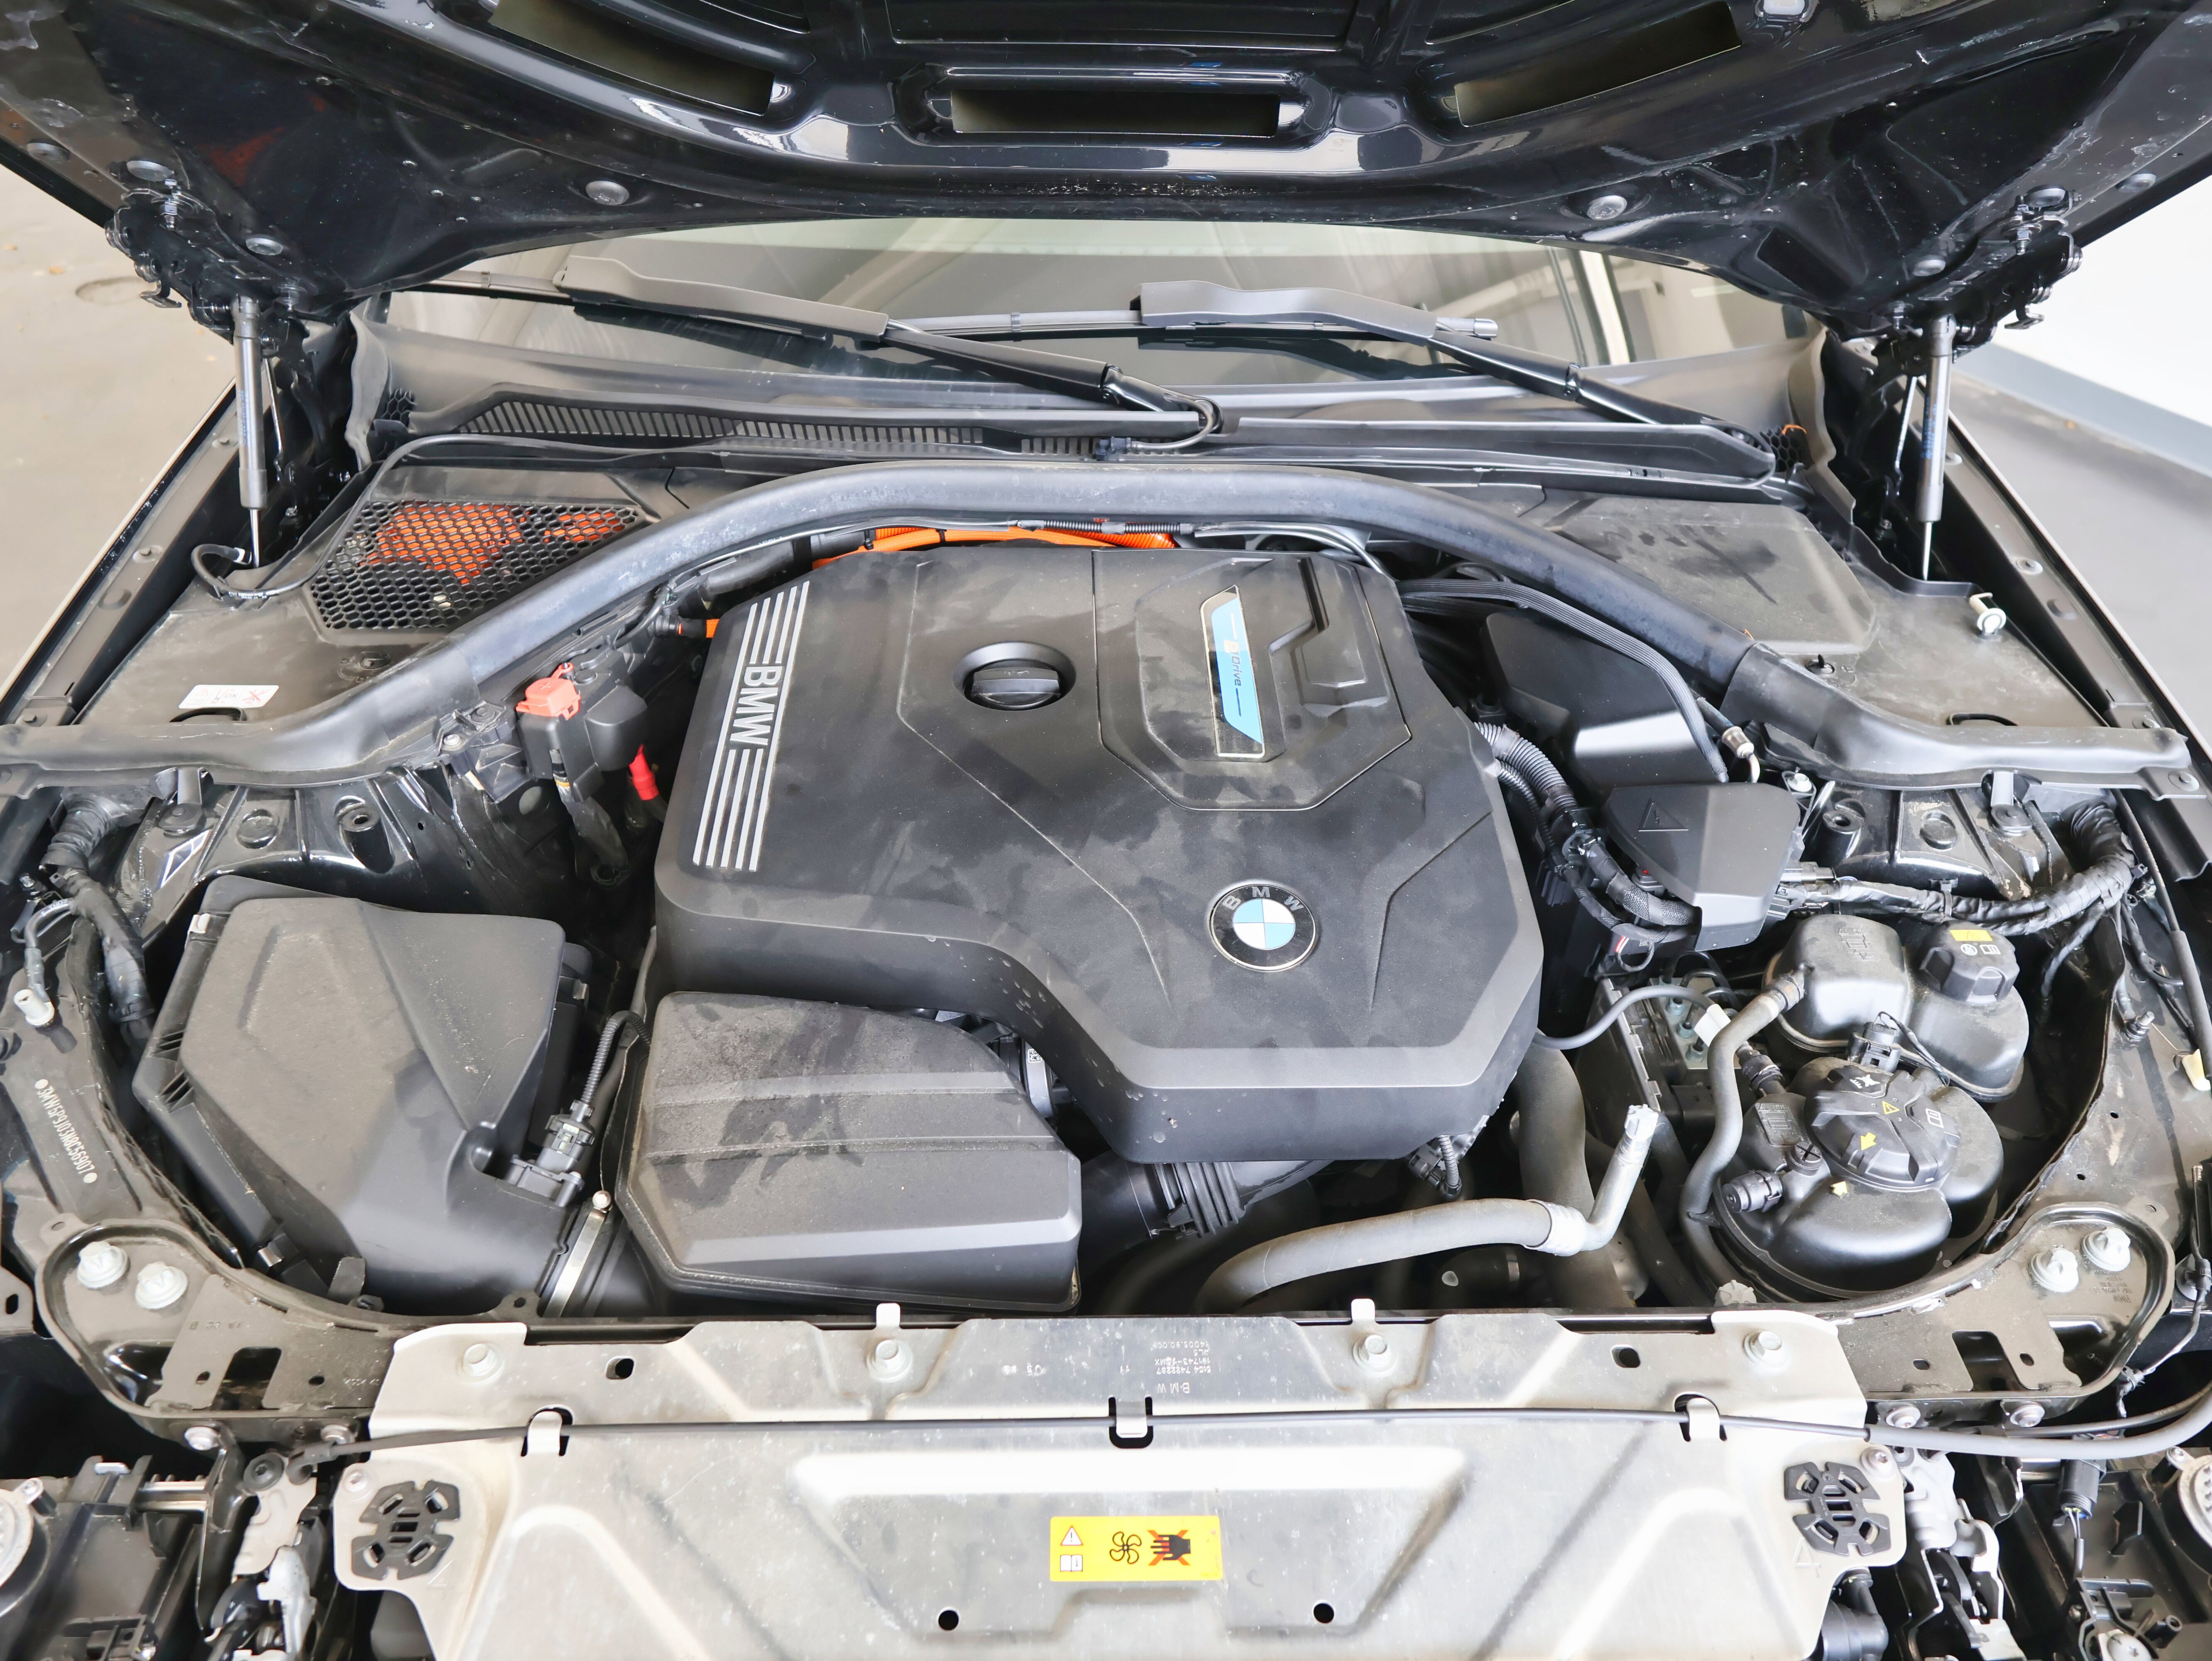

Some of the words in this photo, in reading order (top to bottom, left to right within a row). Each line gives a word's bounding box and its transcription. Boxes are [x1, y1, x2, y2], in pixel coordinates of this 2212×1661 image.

[729, 666, 783, 746] BMW
[1221, 886, 1304, 911] BMW
[1157, 1382, 1190, 1394] BMW
